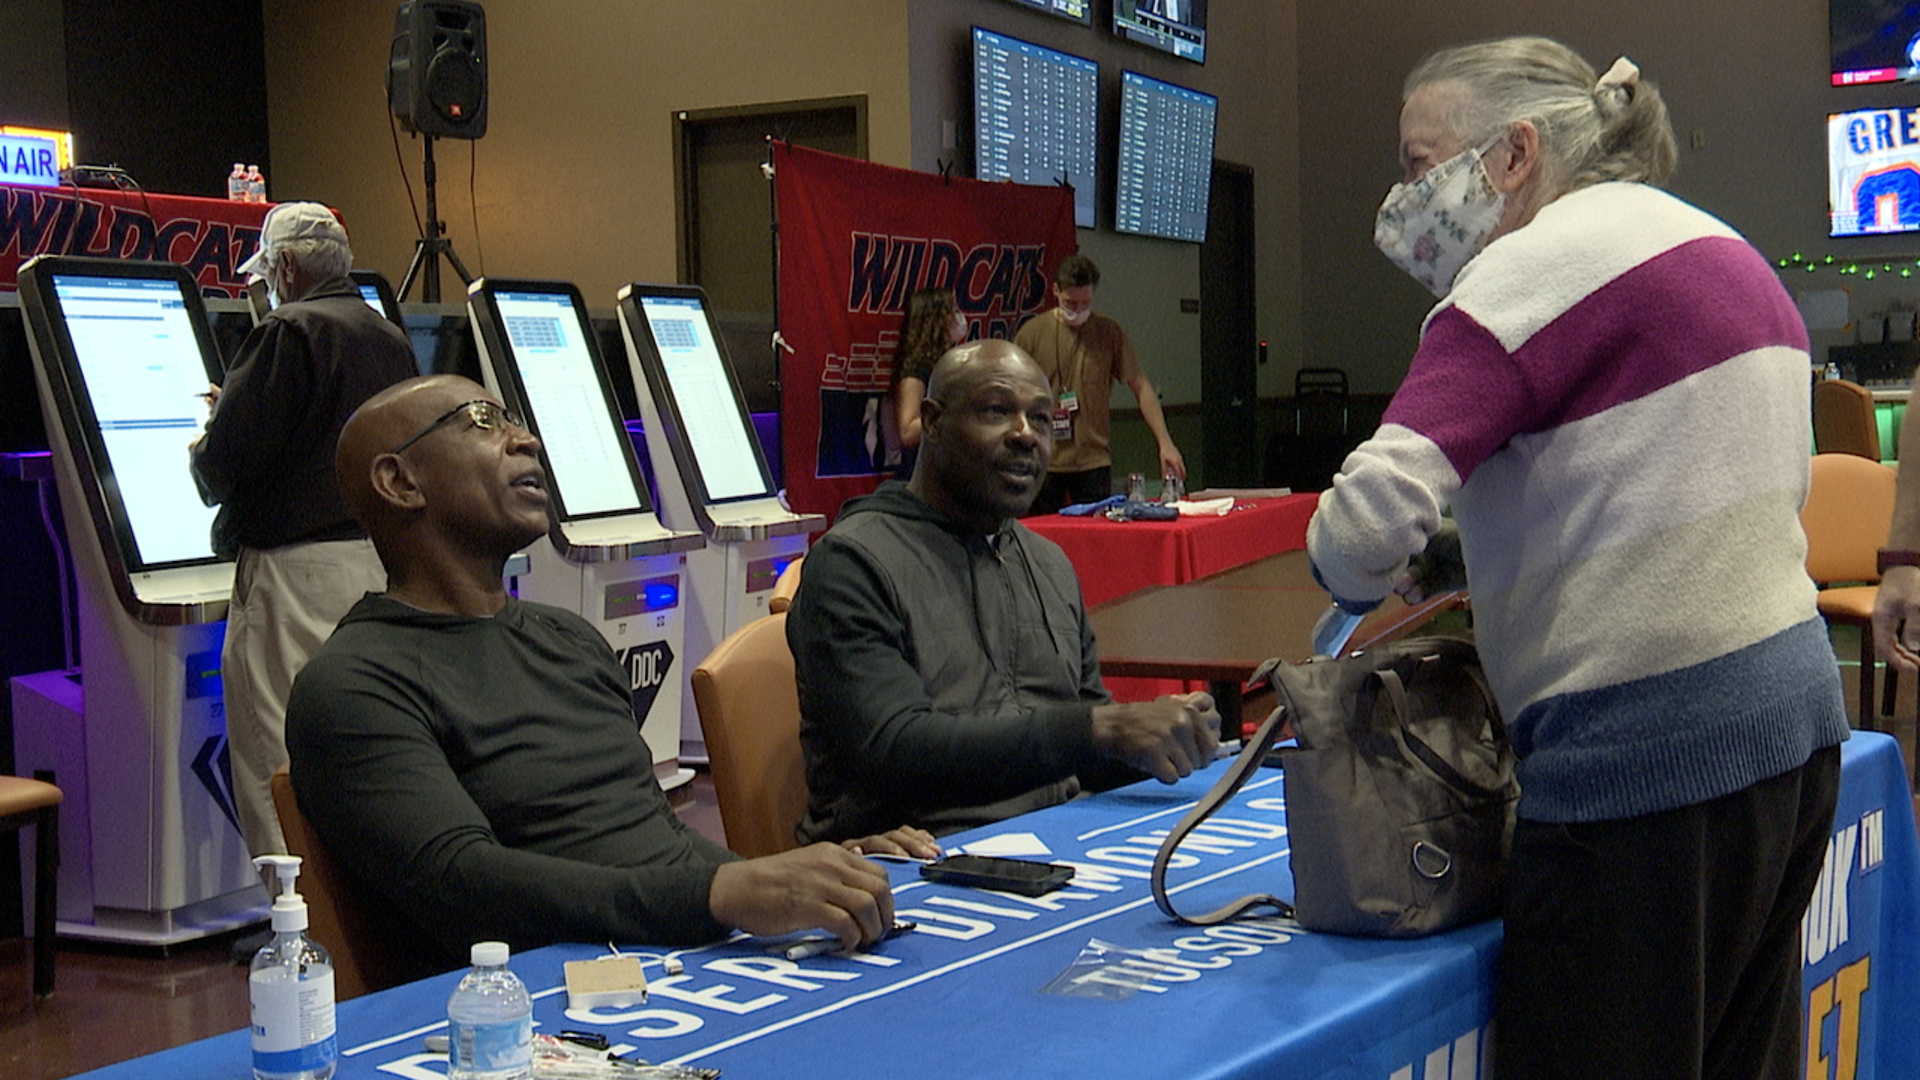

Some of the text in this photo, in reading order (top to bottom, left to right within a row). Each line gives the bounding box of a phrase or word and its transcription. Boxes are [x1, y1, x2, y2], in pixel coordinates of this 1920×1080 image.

[15, 147, 54, 177] AIR
[0, 187, 263, 286] WILDCAT
[848, 231, 1048, 317] WILDCATS
[630, 648, 663, 690] DDC
